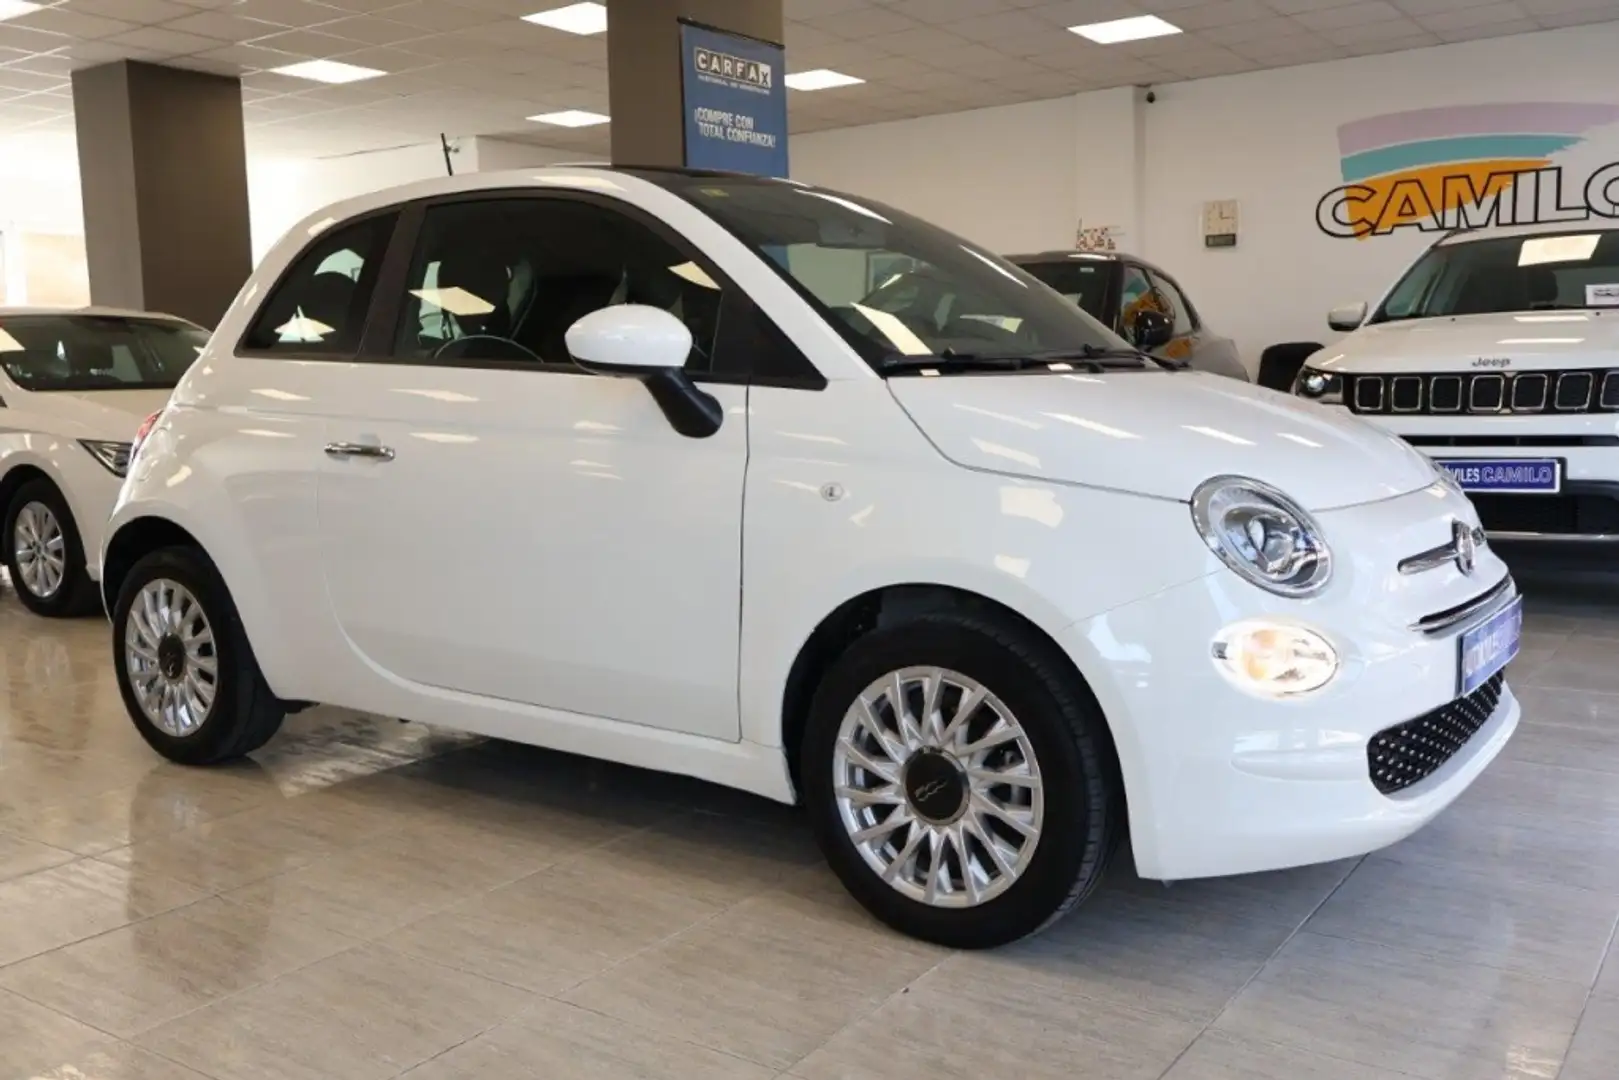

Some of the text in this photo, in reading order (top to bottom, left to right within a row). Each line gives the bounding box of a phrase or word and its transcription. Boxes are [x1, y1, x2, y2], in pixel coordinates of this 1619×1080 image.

[696, 51, 770, 86] CARFAX
[698, 121, 725, 140] TOTAL
[736, 114, 754, 130] CON
[1472, 357, 1511, 368] Jeep
[1481, 466, 1552, 484] CAMILO
